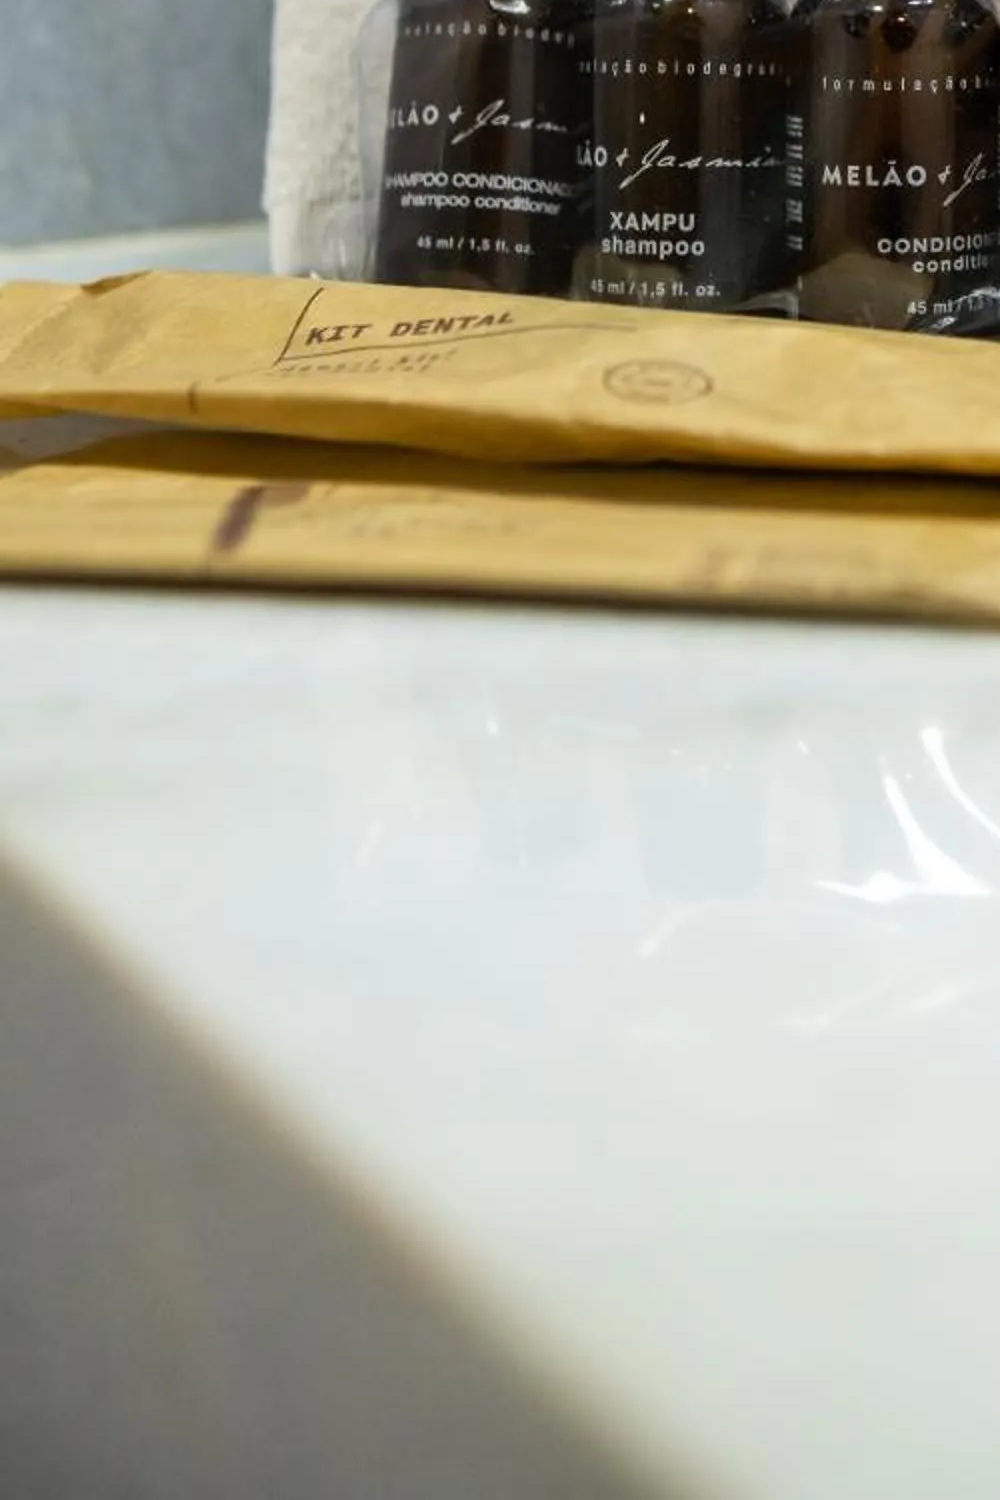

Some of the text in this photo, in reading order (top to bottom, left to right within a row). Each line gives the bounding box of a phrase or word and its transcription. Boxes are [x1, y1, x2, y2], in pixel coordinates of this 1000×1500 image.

[822, 160, 927, 188] MELÃO
[401, 193, 561, 216] shampoo conditioner
[609, 211, 696, 232] XAMPU
[416, 235, 432, 250] 45
[601, 235, 706, 261] shampoo
[607, 281, 625, 295] ml
[641, 281, 665, 299] 1,5
[671, 282, 689, 297] fl.
[695, 285, 721, 297] oz.
[907, 301, 928, 315] 45
[305, 311, 513, 347] KIT DENTAL
